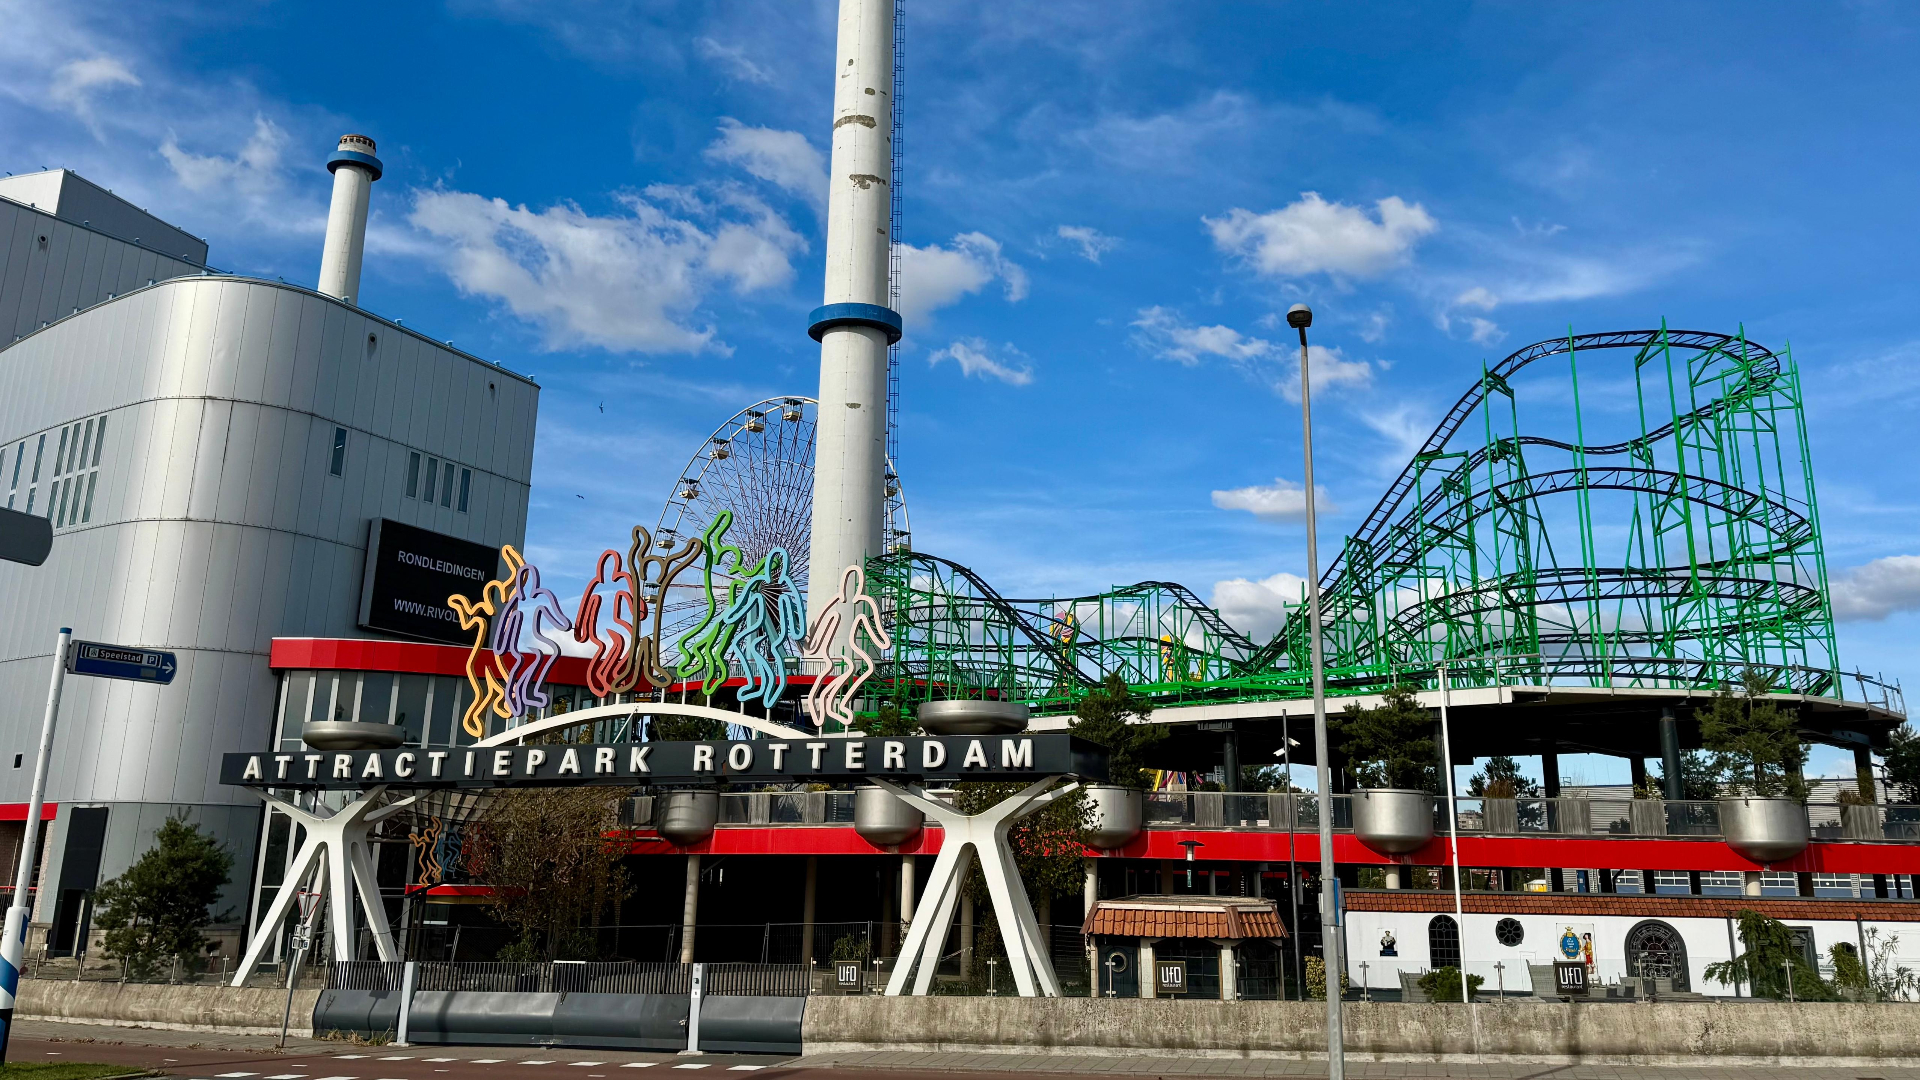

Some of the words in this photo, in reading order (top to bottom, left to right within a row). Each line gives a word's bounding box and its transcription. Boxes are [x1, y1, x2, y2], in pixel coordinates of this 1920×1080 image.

[397, 550, 485, 582] RONDLEIDINGEN
[394, 598, 476, 624] WWW.RIVOL
[99, 649, 142, 662] Speelstad
[242, 746, 652, 780] ATTRACTIEPARK
[693, 739, 1034, 771] ROTTERDAM
